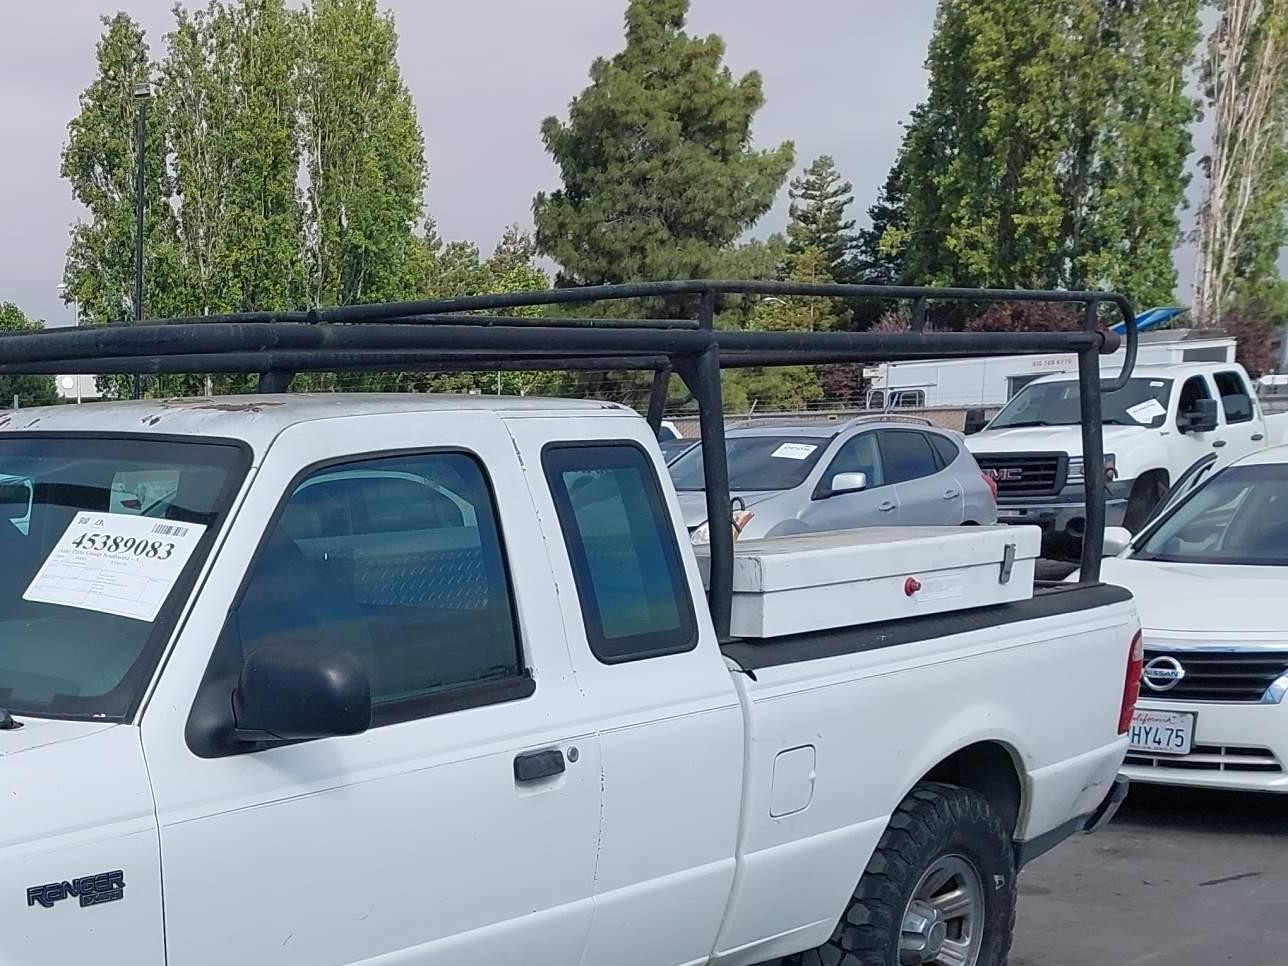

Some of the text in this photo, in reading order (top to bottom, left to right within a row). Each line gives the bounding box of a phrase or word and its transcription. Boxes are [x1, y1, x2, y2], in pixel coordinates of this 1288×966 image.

[72, 532, 175, 560] 45389083
[1144, 669, 1179, 678] NISSAN
[27, 869, 126, 908] RANGER
